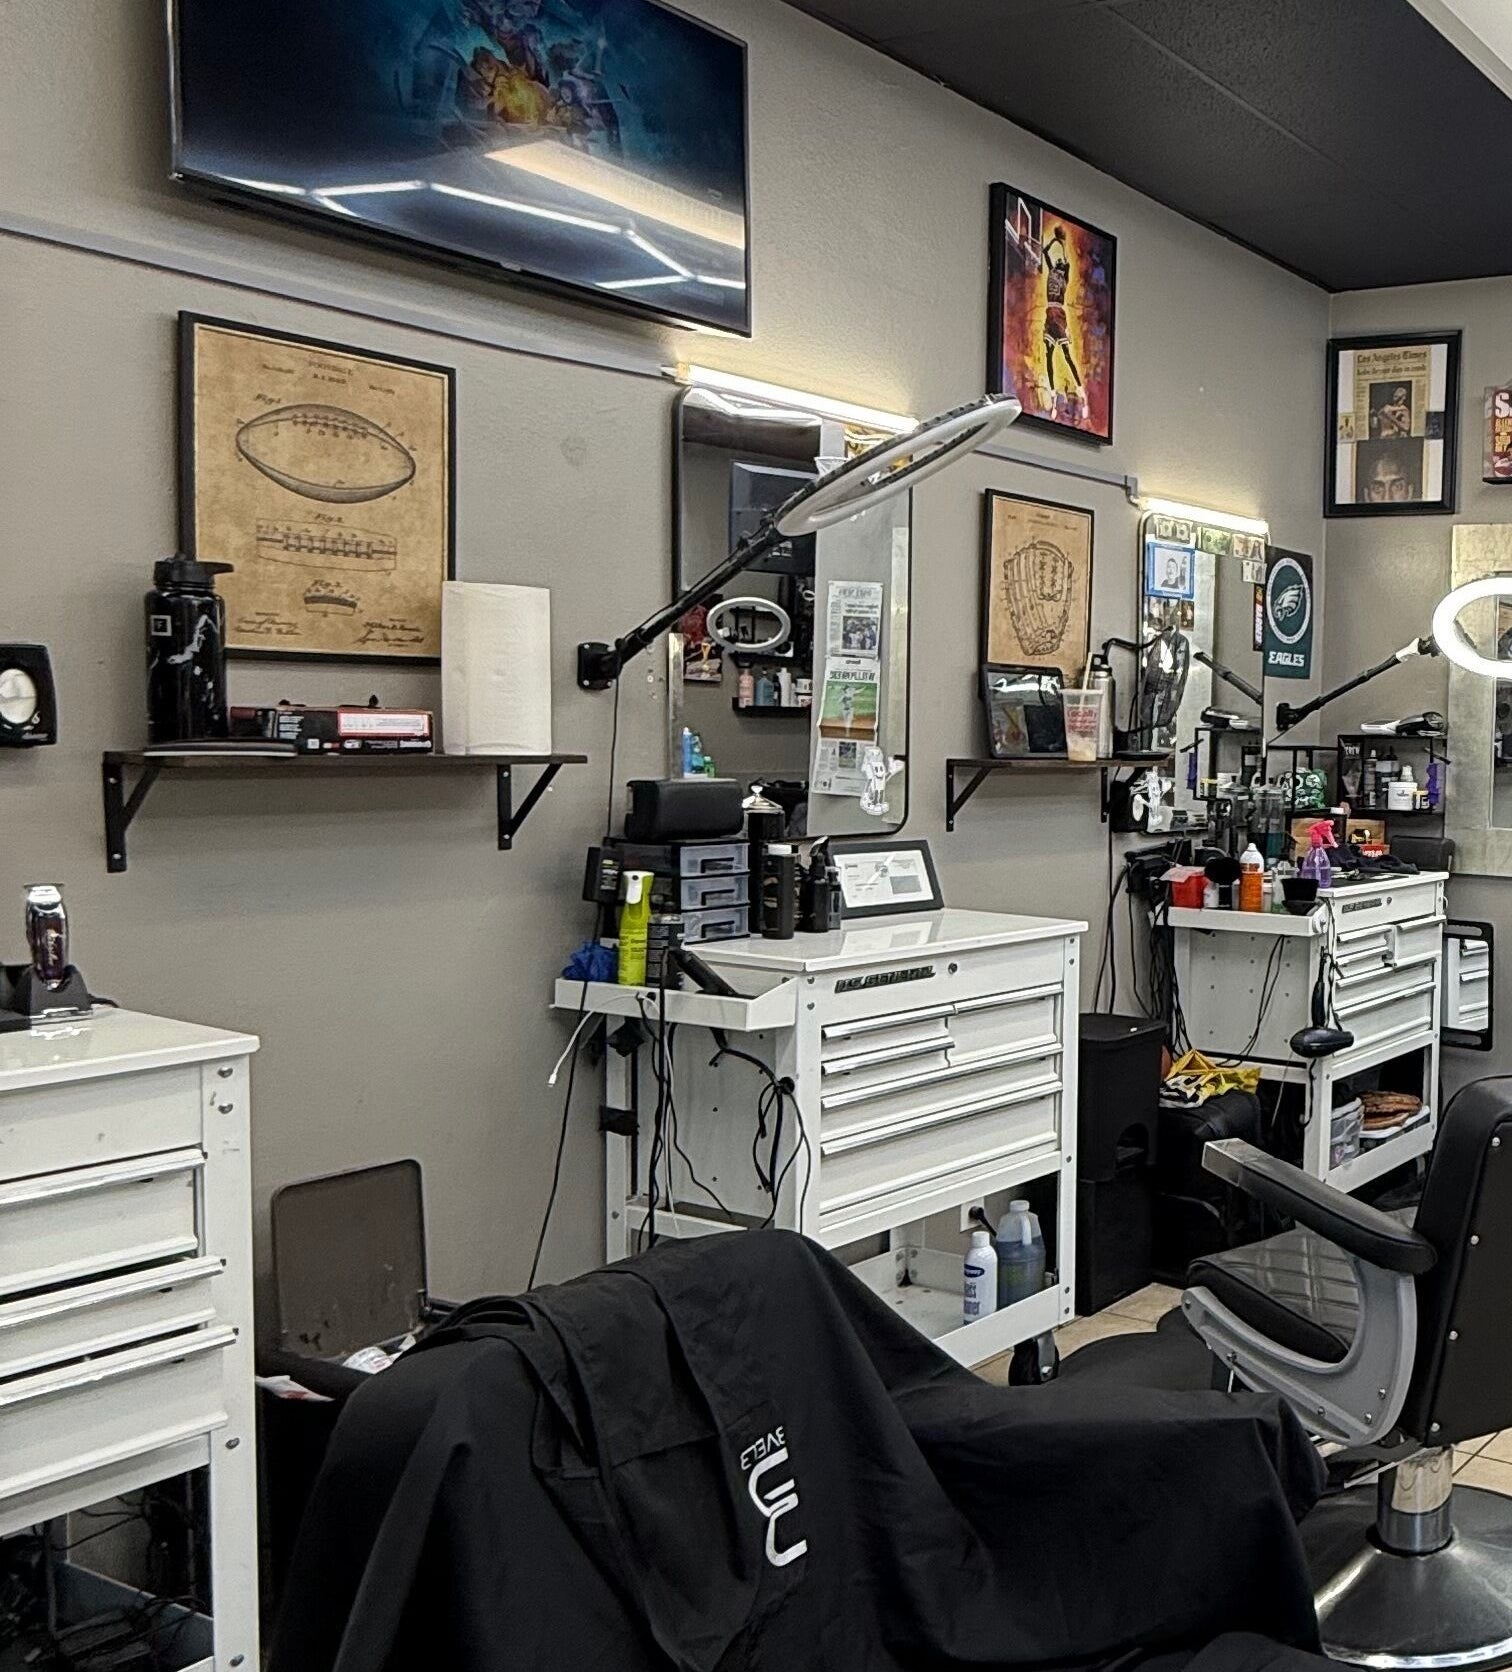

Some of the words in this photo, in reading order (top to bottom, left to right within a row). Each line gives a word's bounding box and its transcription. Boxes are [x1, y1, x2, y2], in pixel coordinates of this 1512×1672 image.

[1357, 354, 1370, 364] Los
[1373, 352, 1400, 364] Angeles
[1402, 350, 1427, 360] Times
[1268, 651, 1305, 667] EAGLES
